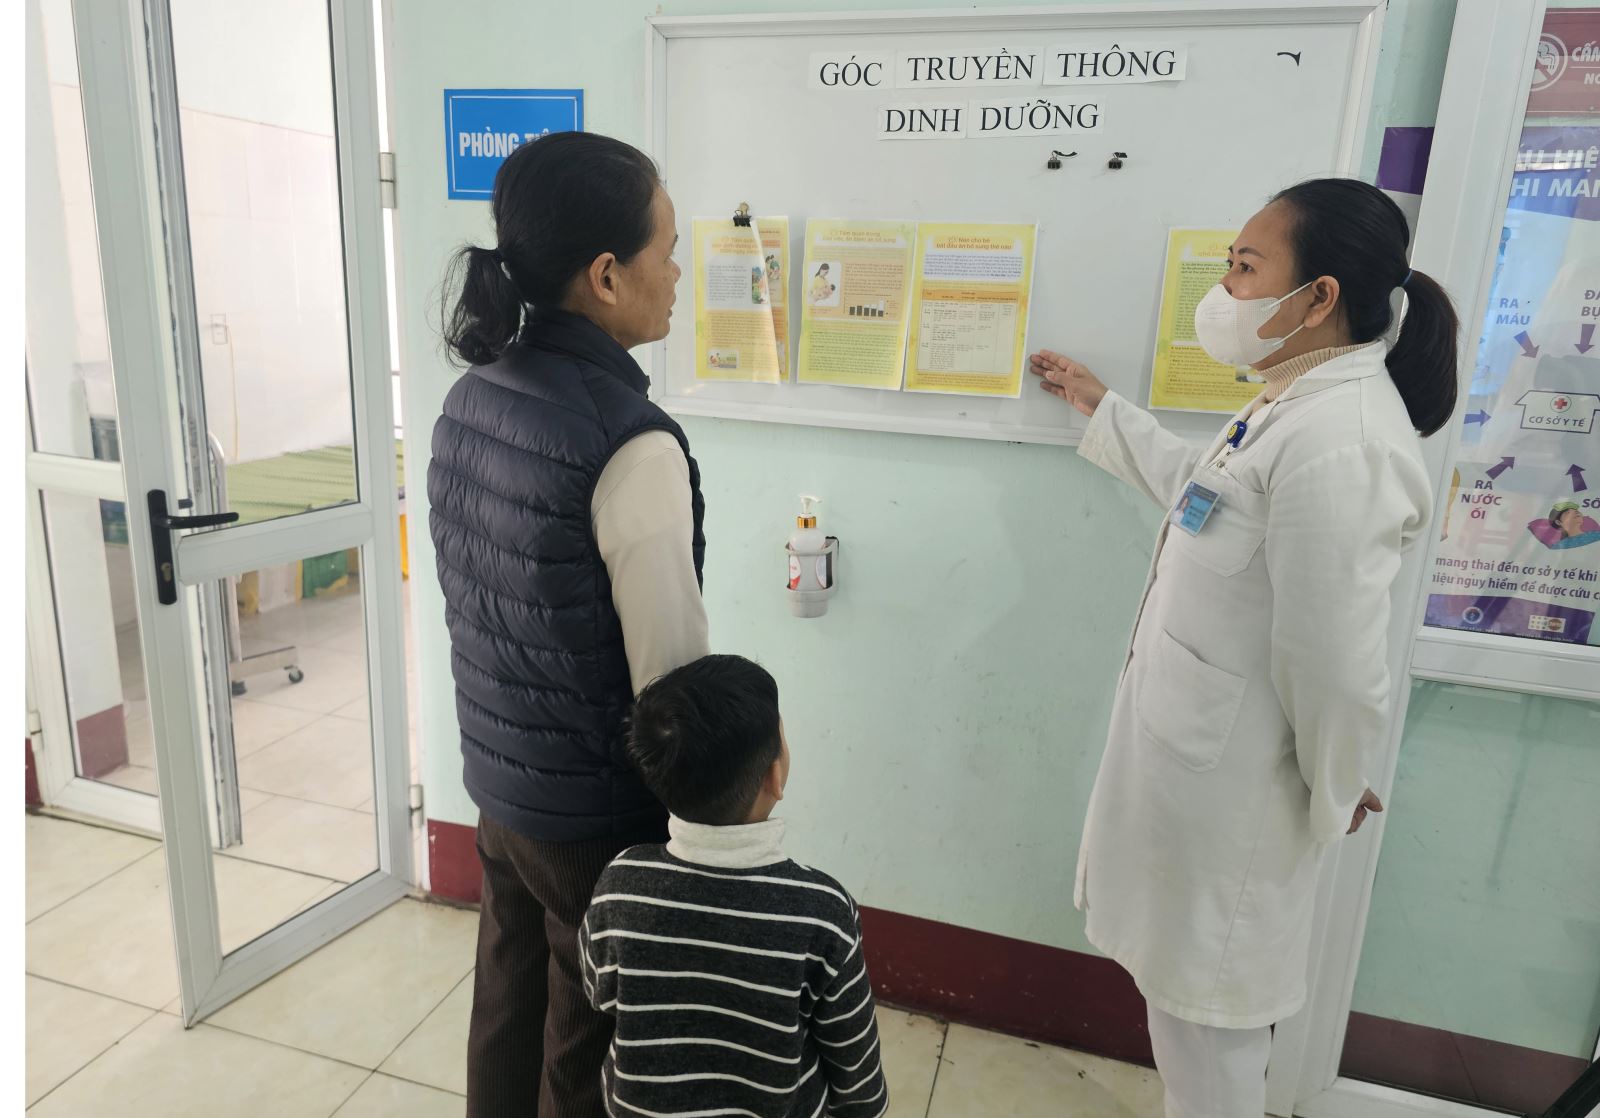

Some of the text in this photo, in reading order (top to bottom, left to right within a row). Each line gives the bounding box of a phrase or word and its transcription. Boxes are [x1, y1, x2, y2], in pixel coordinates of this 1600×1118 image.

[818, 43, 1177, 87] GÓC TRUYỀN THÔNG
[884, 99, 1099, 133] DINH DƯỠNG
[459, 126, 520, 158] PHÒNG
[1499, 297, 1519, 309] RA
[1496, 312, 1530, 325] MÁU
[1528, 416, 1544, 424] CƠ
[1563, 418, 1569, 426] Y
[1474, 479, 1493, 490] RA
[1460, 493, 1502, 506] NƯỚC
[1435, 557, 1598, 582] mang thai đến cơ sở y tế khi
[1456, 576, 1486, 589] nguy
[1488, 577, 1518, 591] hiểm
[1520, 580, 1537, 593] để
[1538, 583, 1567, 598] được
[1569, 586, 1591, 599] cứu
